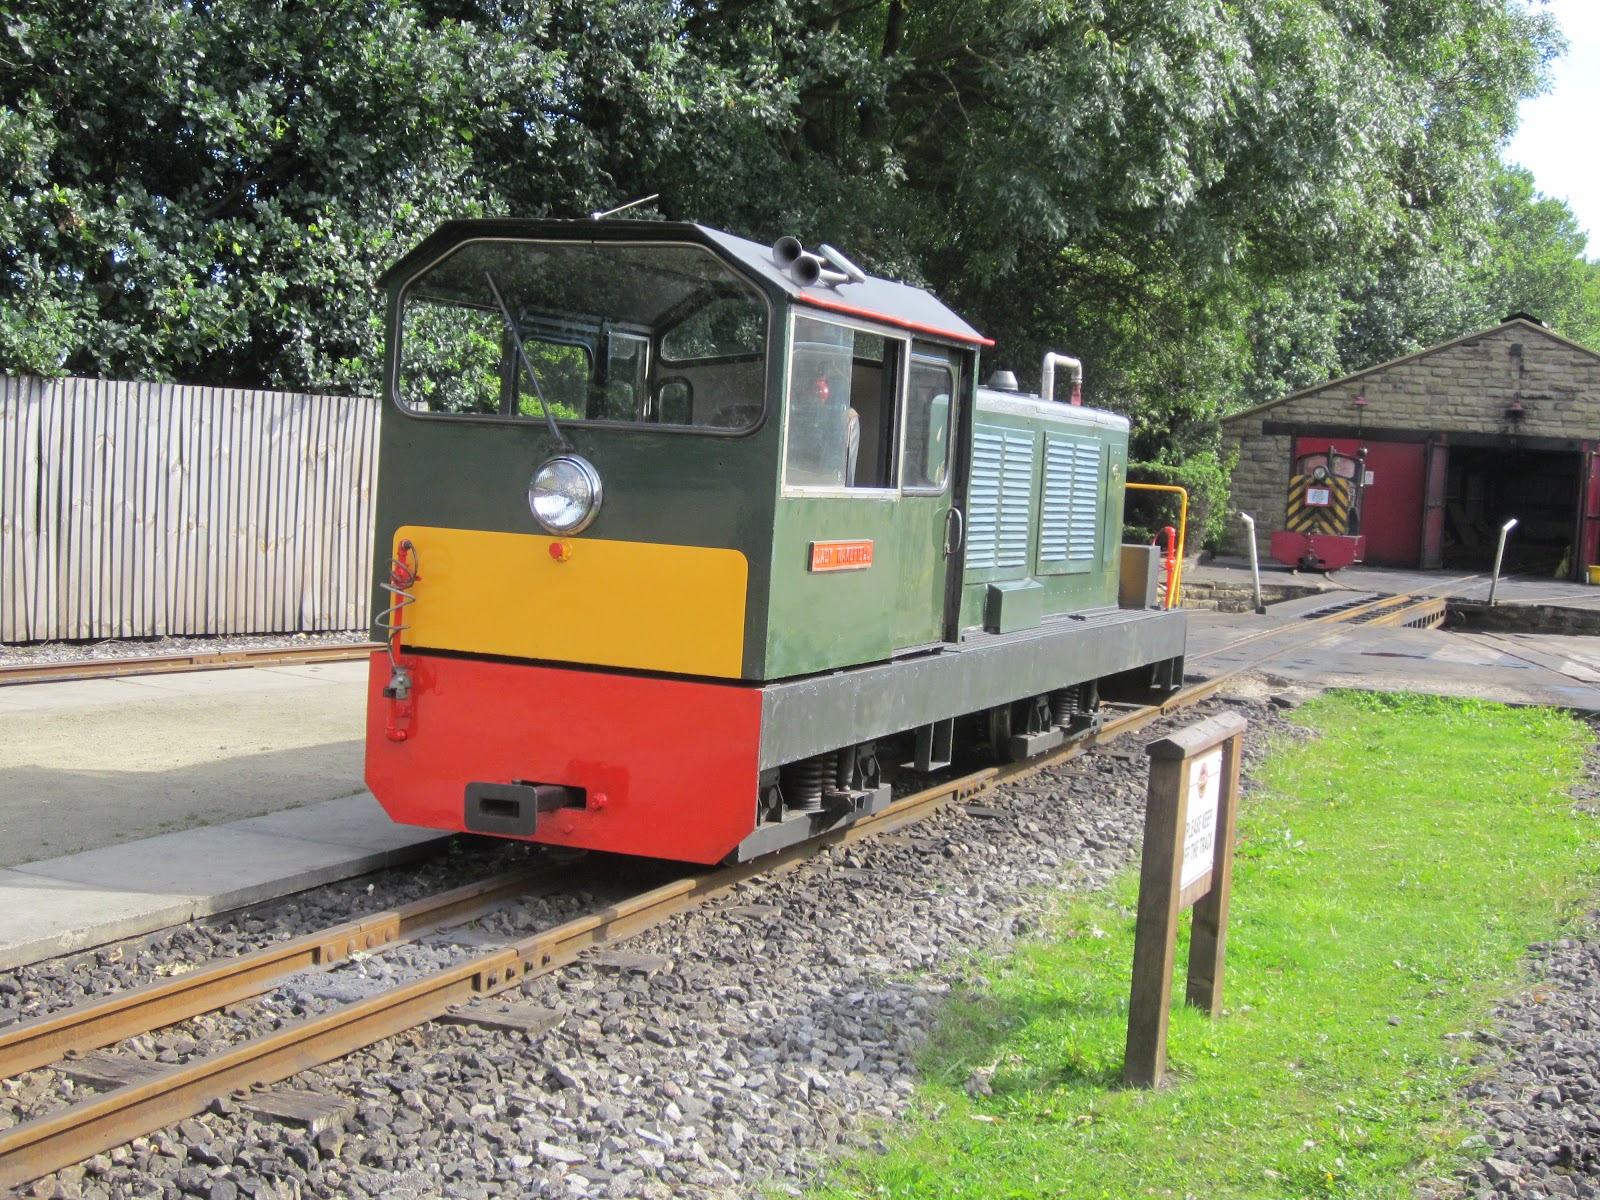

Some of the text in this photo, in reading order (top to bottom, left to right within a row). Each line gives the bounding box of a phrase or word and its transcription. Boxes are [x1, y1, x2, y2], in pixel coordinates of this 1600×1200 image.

[1202, 808, 1213, 829] KEEP
[1190, 840, 1199, 860] THE
[1199, 830, 1213, 854] TRACK
